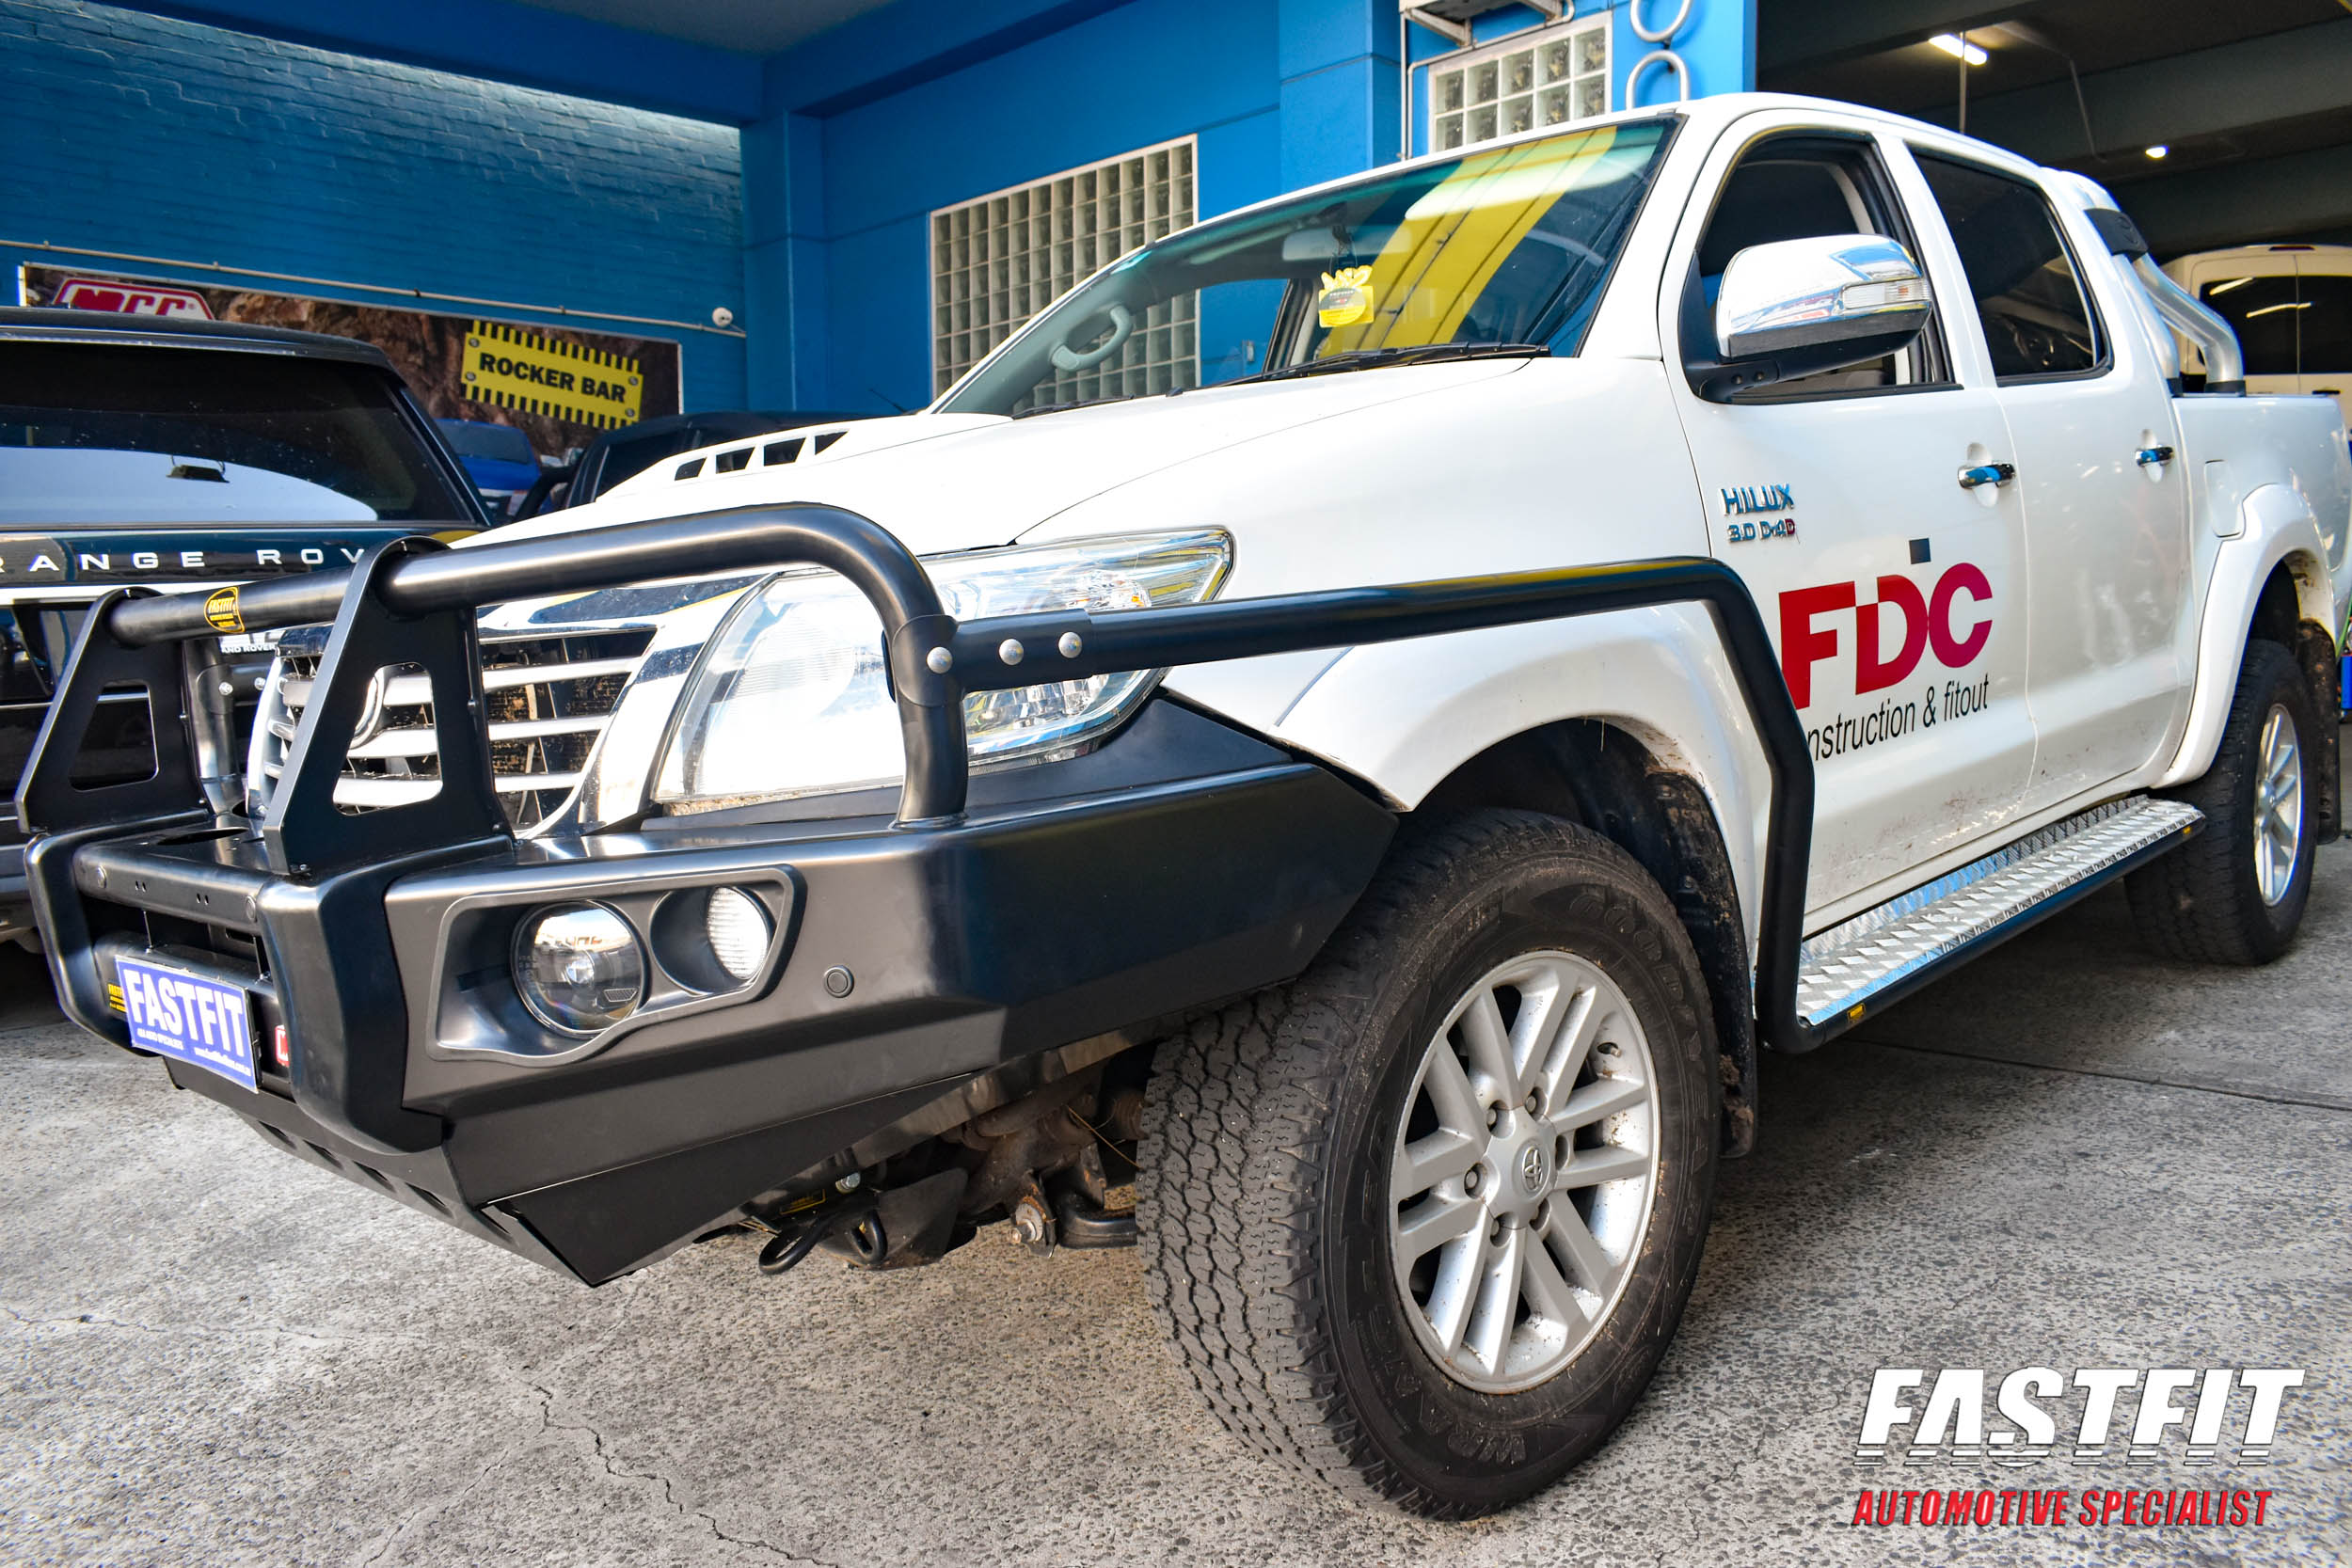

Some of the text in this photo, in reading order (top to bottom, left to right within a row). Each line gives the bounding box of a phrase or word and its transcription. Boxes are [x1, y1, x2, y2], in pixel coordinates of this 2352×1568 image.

[479, 351, 628, 404] ROCKER BAR
[1718, 483, 1795, 516] HILUX
[1756, 517, 1796, 541] D-4D
[0, 552, 206, 573] ANGE
[1778, 562, 1994, 711] FDC
[1922, 686, 1937, 728] &
[1944, 673, 1990, 721] fitout
[123, 968, 245, 1058] FASTFIT
